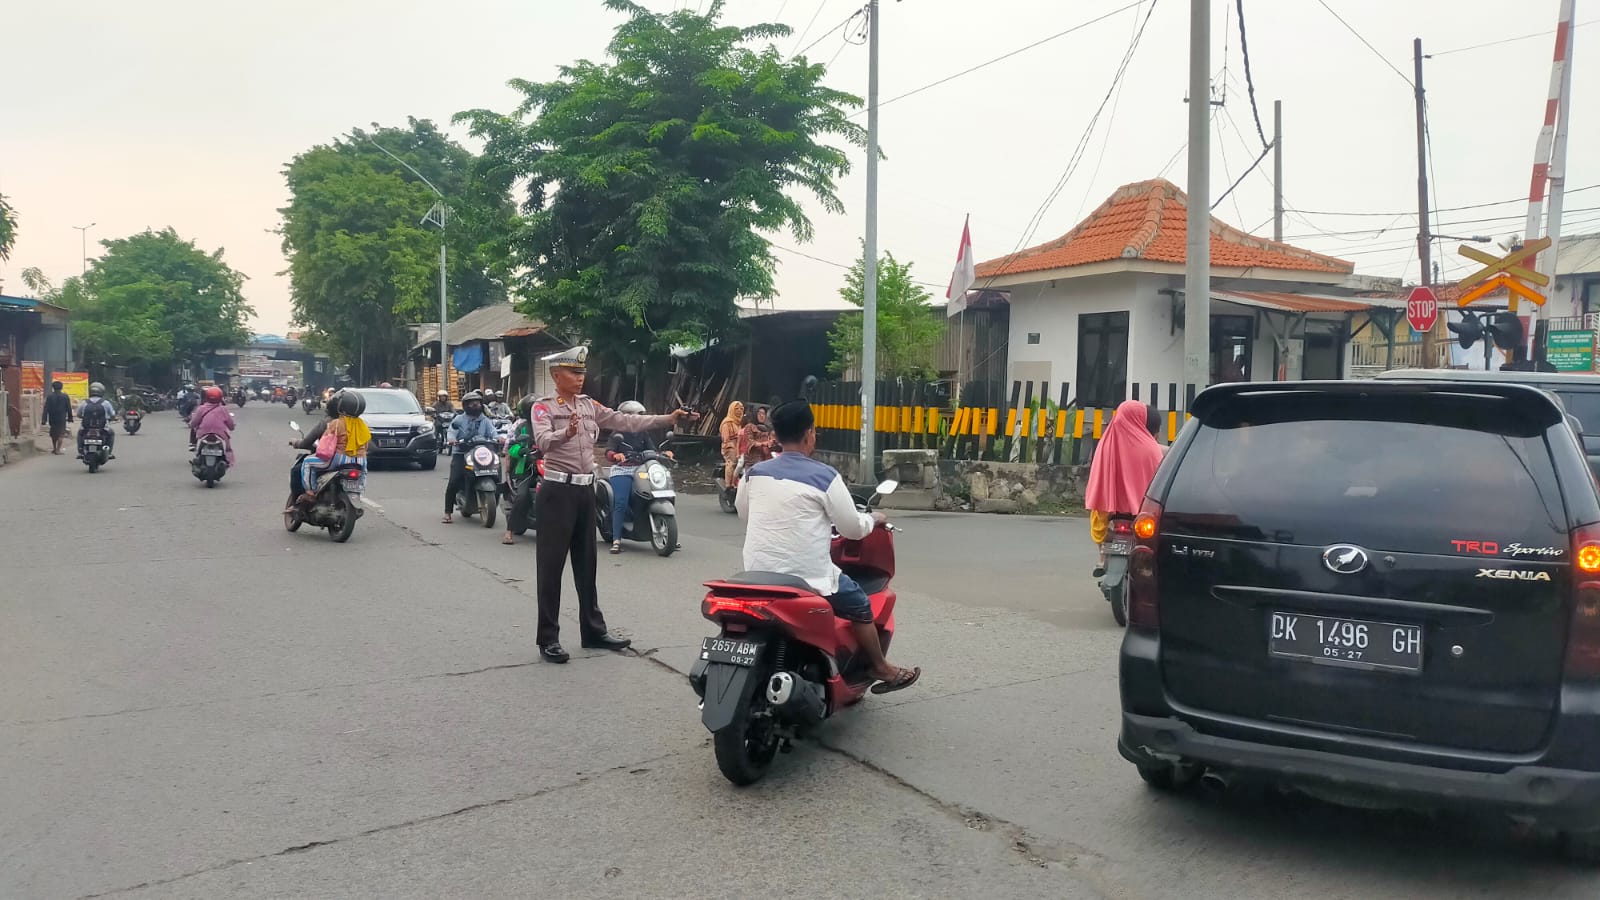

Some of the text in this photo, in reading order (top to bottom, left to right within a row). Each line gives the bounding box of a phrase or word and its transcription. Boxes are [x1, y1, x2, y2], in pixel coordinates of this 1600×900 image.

[1408, 300, 1435, 318] STOP
[1450, 539, 1564, 557] TRD Sportivo
[1475, 568, 1552, 581] XENIA
[1272, 614, 1421, 654] DK 1496 GH
[702, 638, 757, 655] L 2657 ABM
